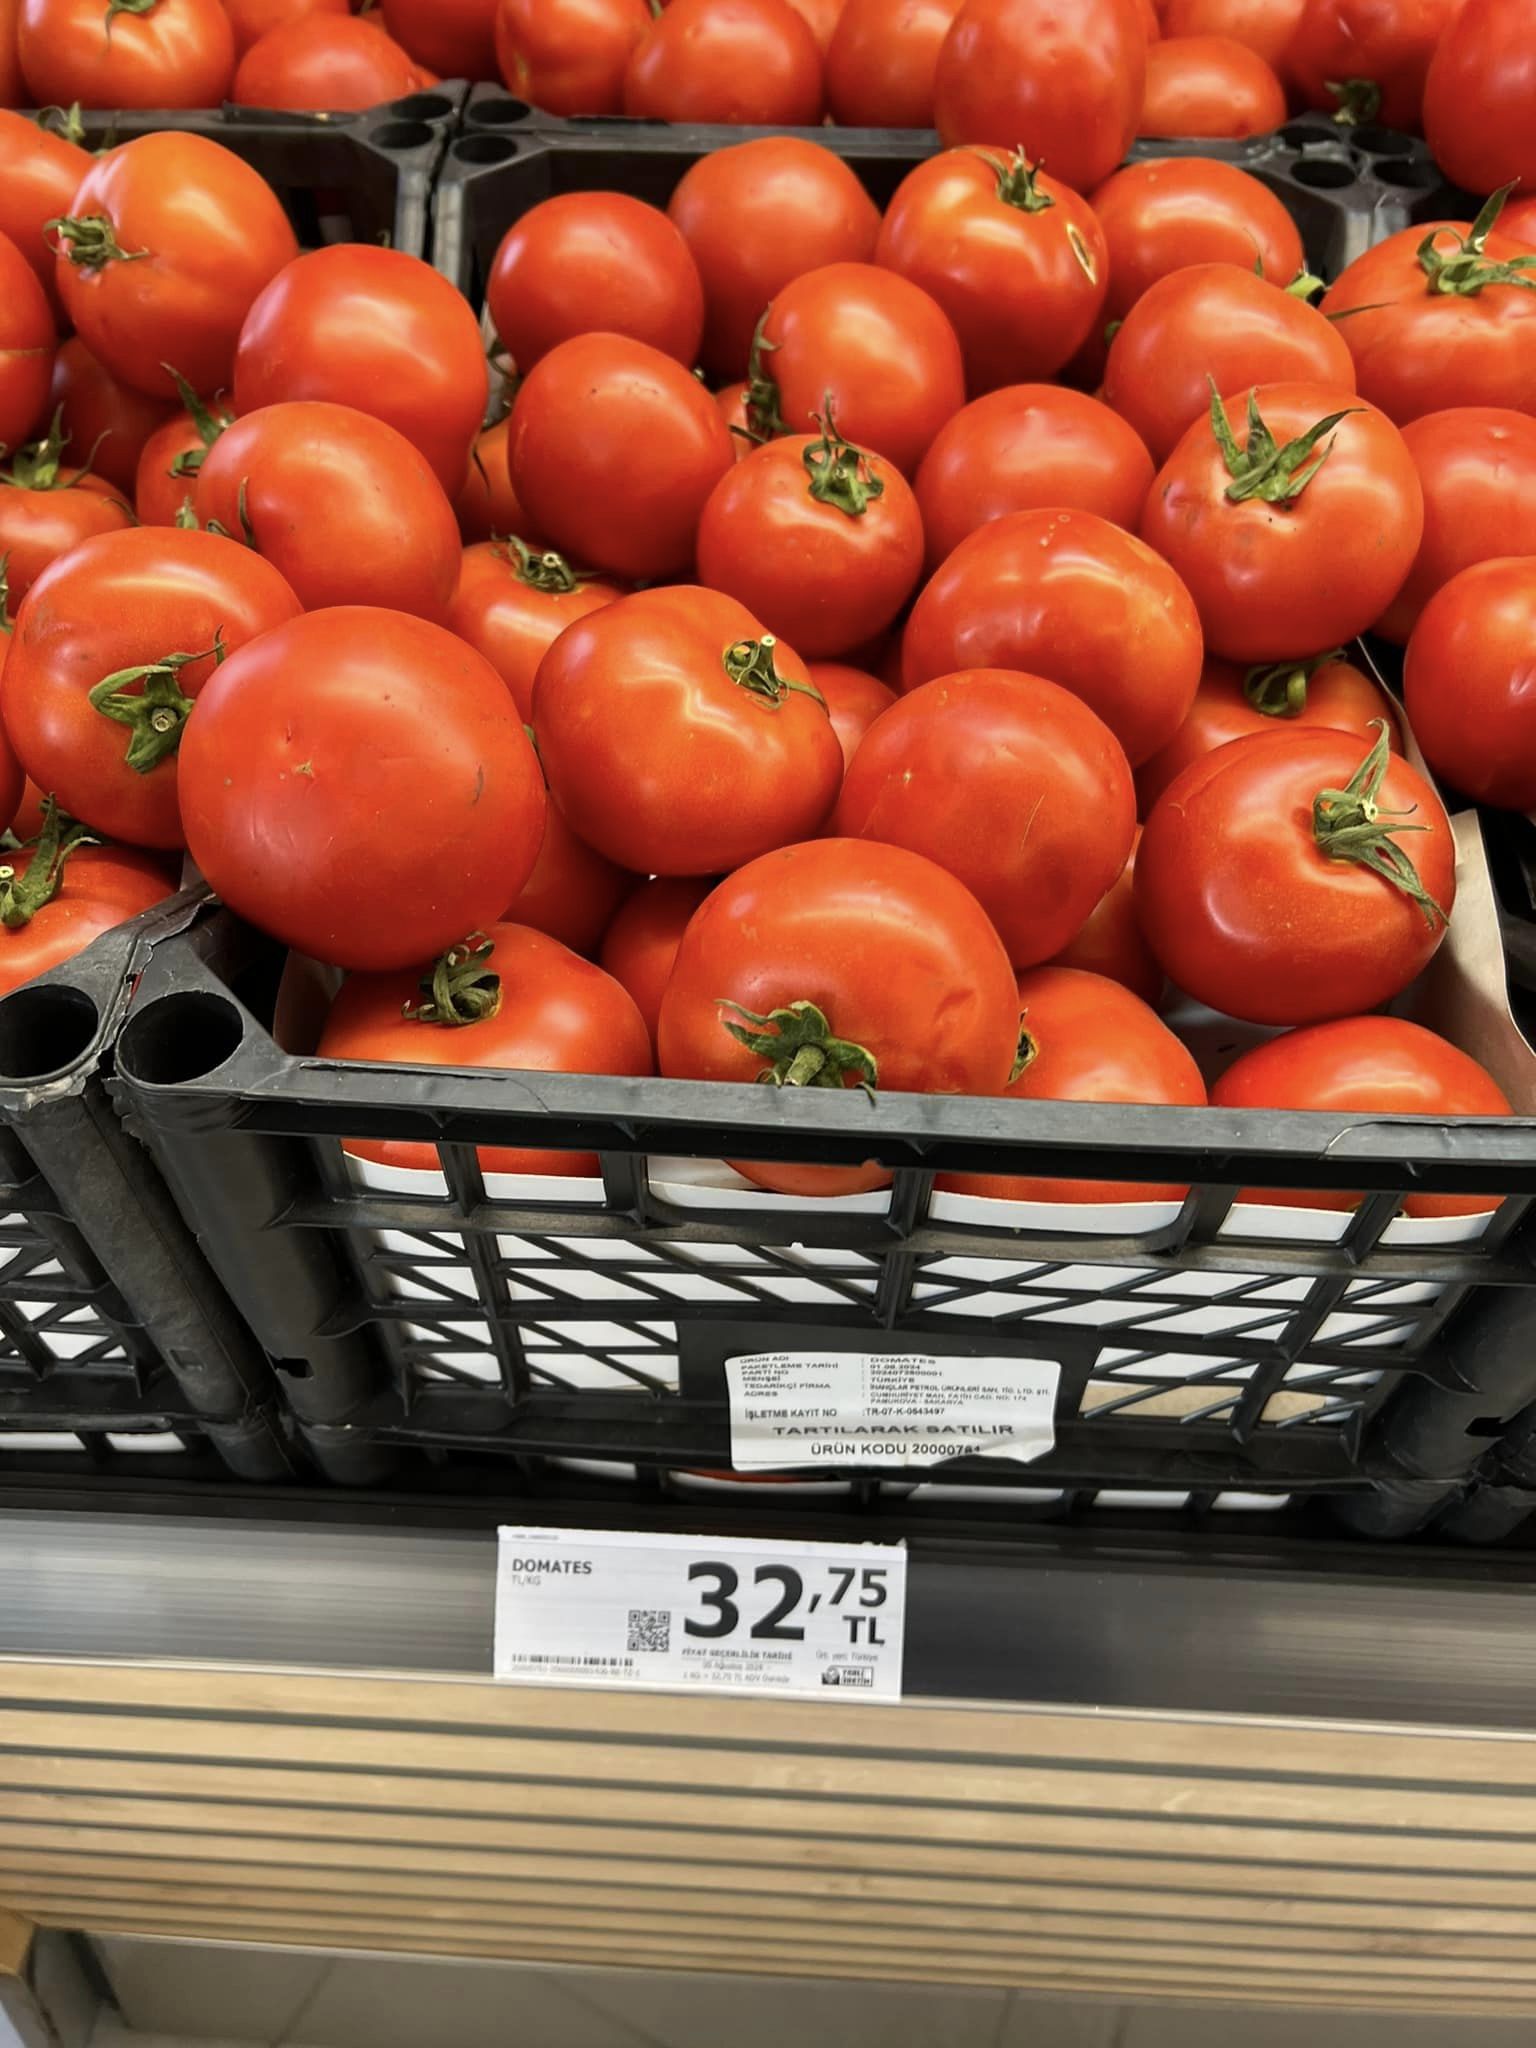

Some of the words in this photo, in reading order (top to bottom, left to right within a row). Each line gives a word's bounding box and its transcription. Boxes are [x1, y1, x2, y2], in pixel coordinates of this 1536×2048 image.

[745, 1408, 788, 1421] İŞLETME
[790, 1408, 819, 1418] KAYIT
[822, 1408, 837, 1417] NO
[773, 1425, 918, 1435] TARTILARAK
[926, 1425, 1014, 1435] SATILIR
[811, 1443, 856, 1455] ÜRÜN
[861, 1443, 906, 1455] KODU
[512, 1558, 593, 1575] DOMATES
[512, 1574, 541, 1586] TL/KG
[842, 1615, 885, 1645] TL
